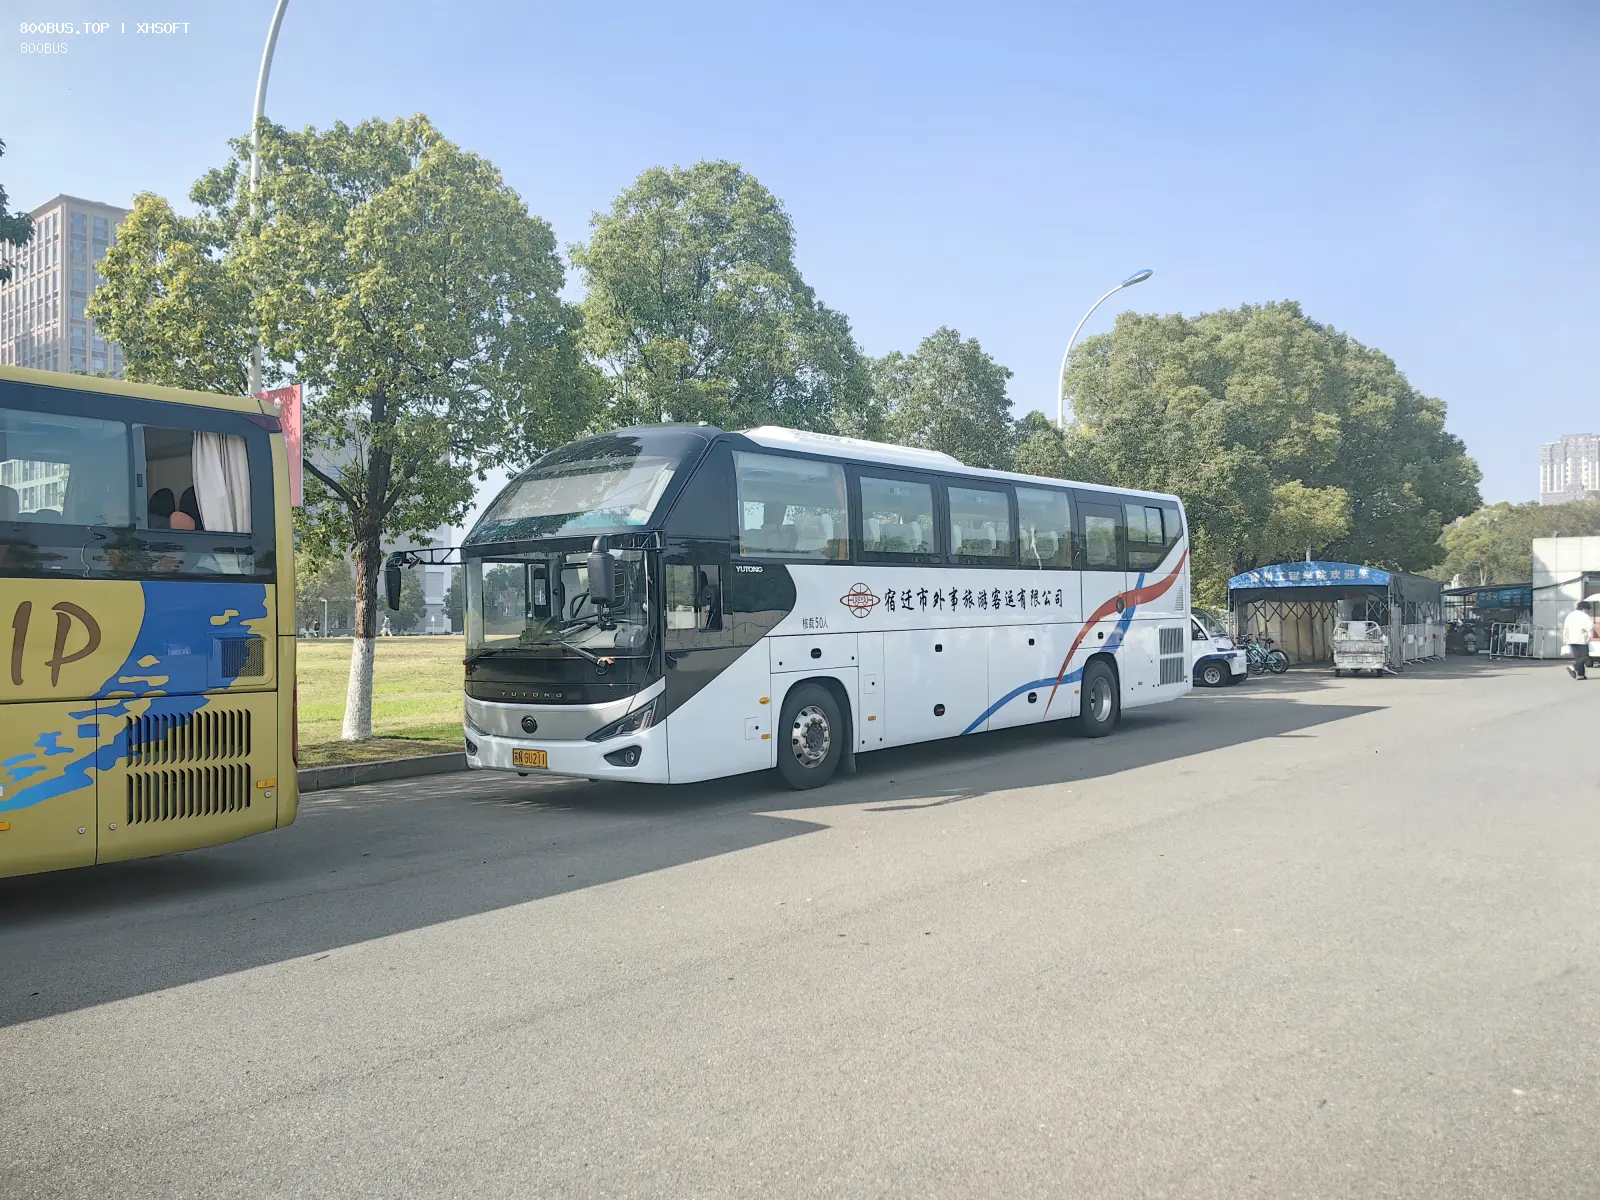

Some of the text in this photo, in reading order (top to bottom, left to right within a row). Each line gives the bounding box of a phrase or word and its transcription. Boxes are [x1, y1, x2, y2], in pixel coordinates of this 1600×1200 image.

[735, 565, 764, 573] YUTONG
[884, 586, 1063, 612] 宿迁市外事旅游客运有限公司
[802, 616, 829, 630] 核载50人
